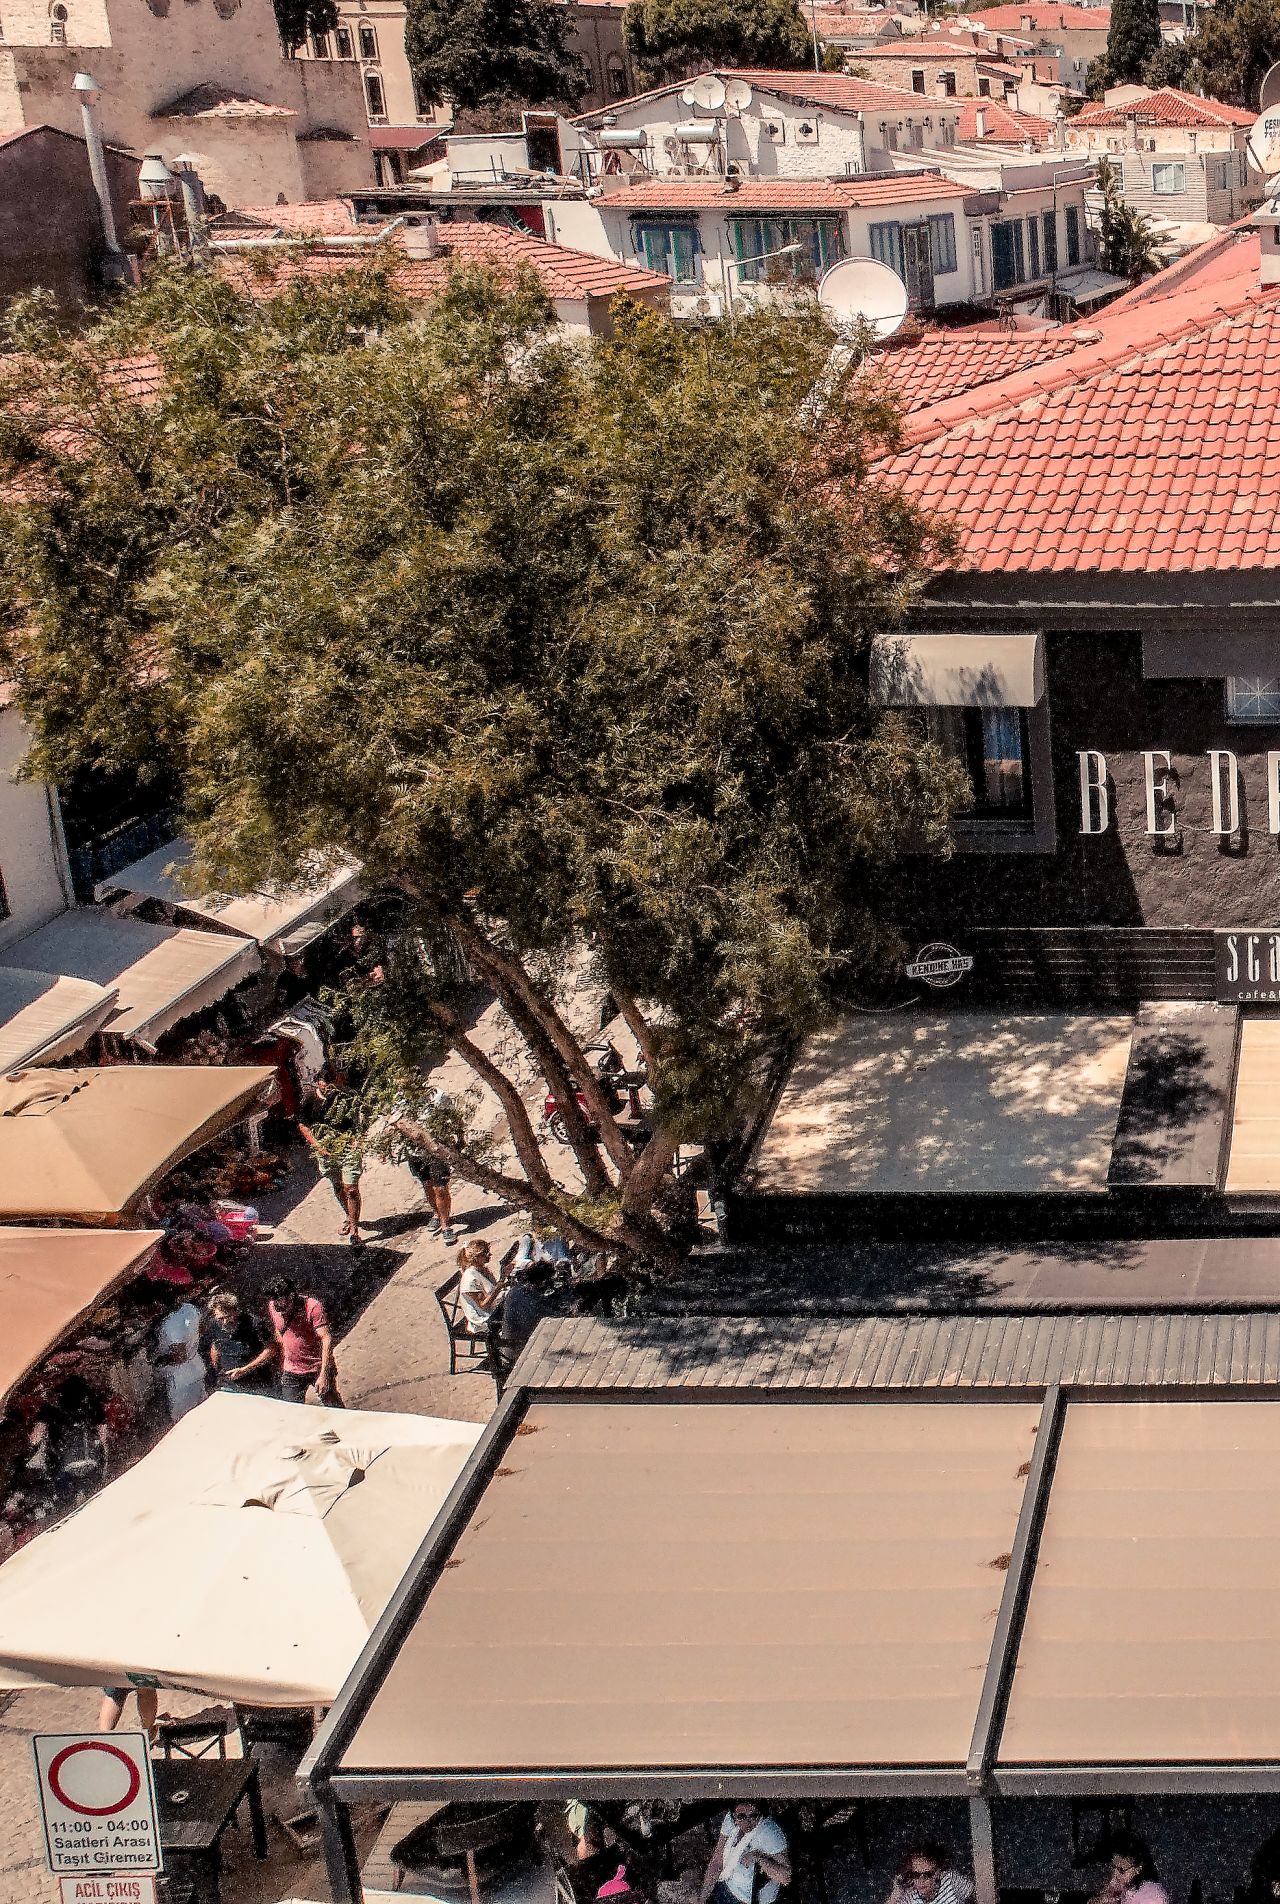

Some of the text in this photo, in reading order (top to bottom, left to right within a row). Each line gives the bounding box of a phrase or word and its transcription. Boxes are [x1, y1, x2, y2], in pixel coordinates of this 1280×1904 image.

[51, 1821, 92, 1833] 11:00
[107, 1820, 149, 1832] 04:00
[55, 1836, 151, 1849] Saatleri Arası
[55, 1852, 153, 1866] Taşıt Giremez
[75, 1880, 141, 1900] ACİL ÇIKIŞ
